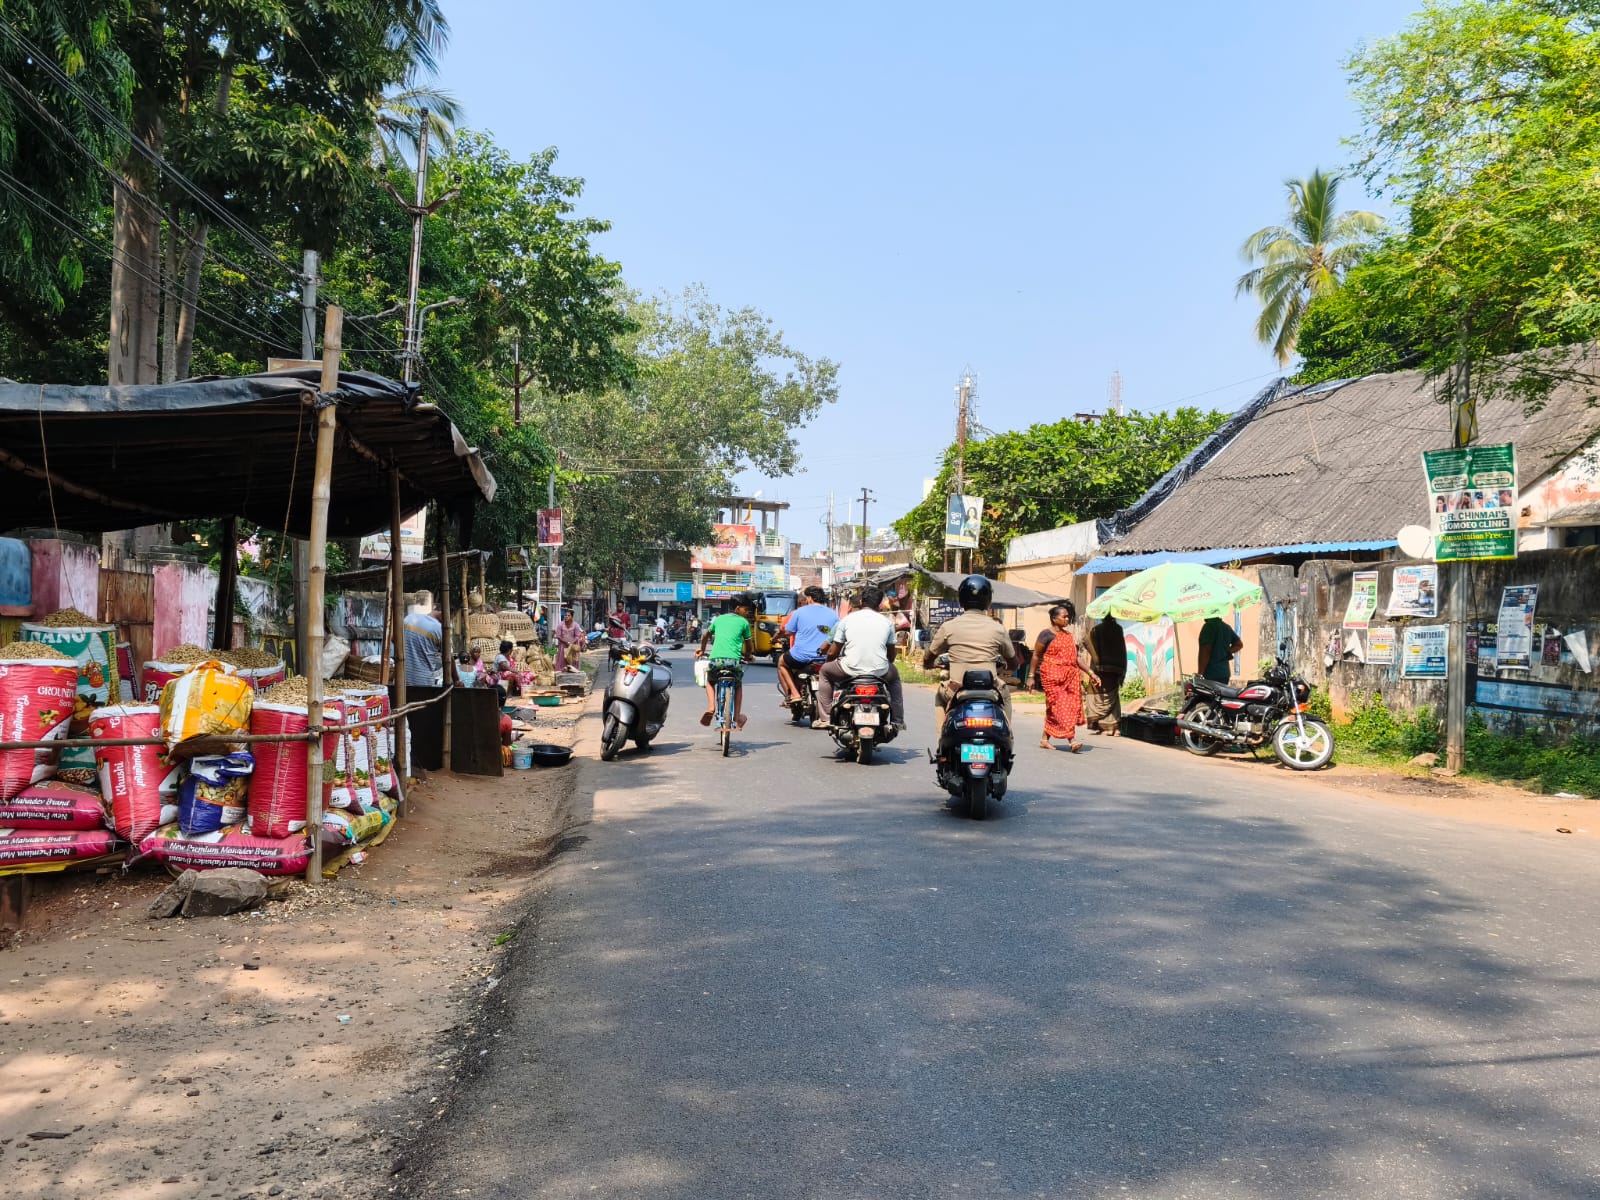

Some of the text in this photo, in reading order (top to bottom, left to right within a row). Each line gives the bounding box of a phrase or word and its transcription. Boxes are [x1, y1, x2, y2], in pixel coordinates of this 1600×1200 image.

[1458, 510, 1508, 520] CHINMAI'S
[1478, 519, 1508, 529] CLINIC
[114, 761, 127, 796] Khushi
[46, 798, 71, 807] Brand
[16, 811, 50, 820] Premium
[47, 835, 72, 843] Brand
[16, 848, 52, 858] Premium
[53, 847, 70, 855] New
[169, 842, 184, 851] New
[186, 844, 219, 854] Premium
[254, 847, 278, 857] Brand
[168, 855, 192, 865] Brand
[227, 859, 260, 869] Premium
[260, 861, 277, 869] New
